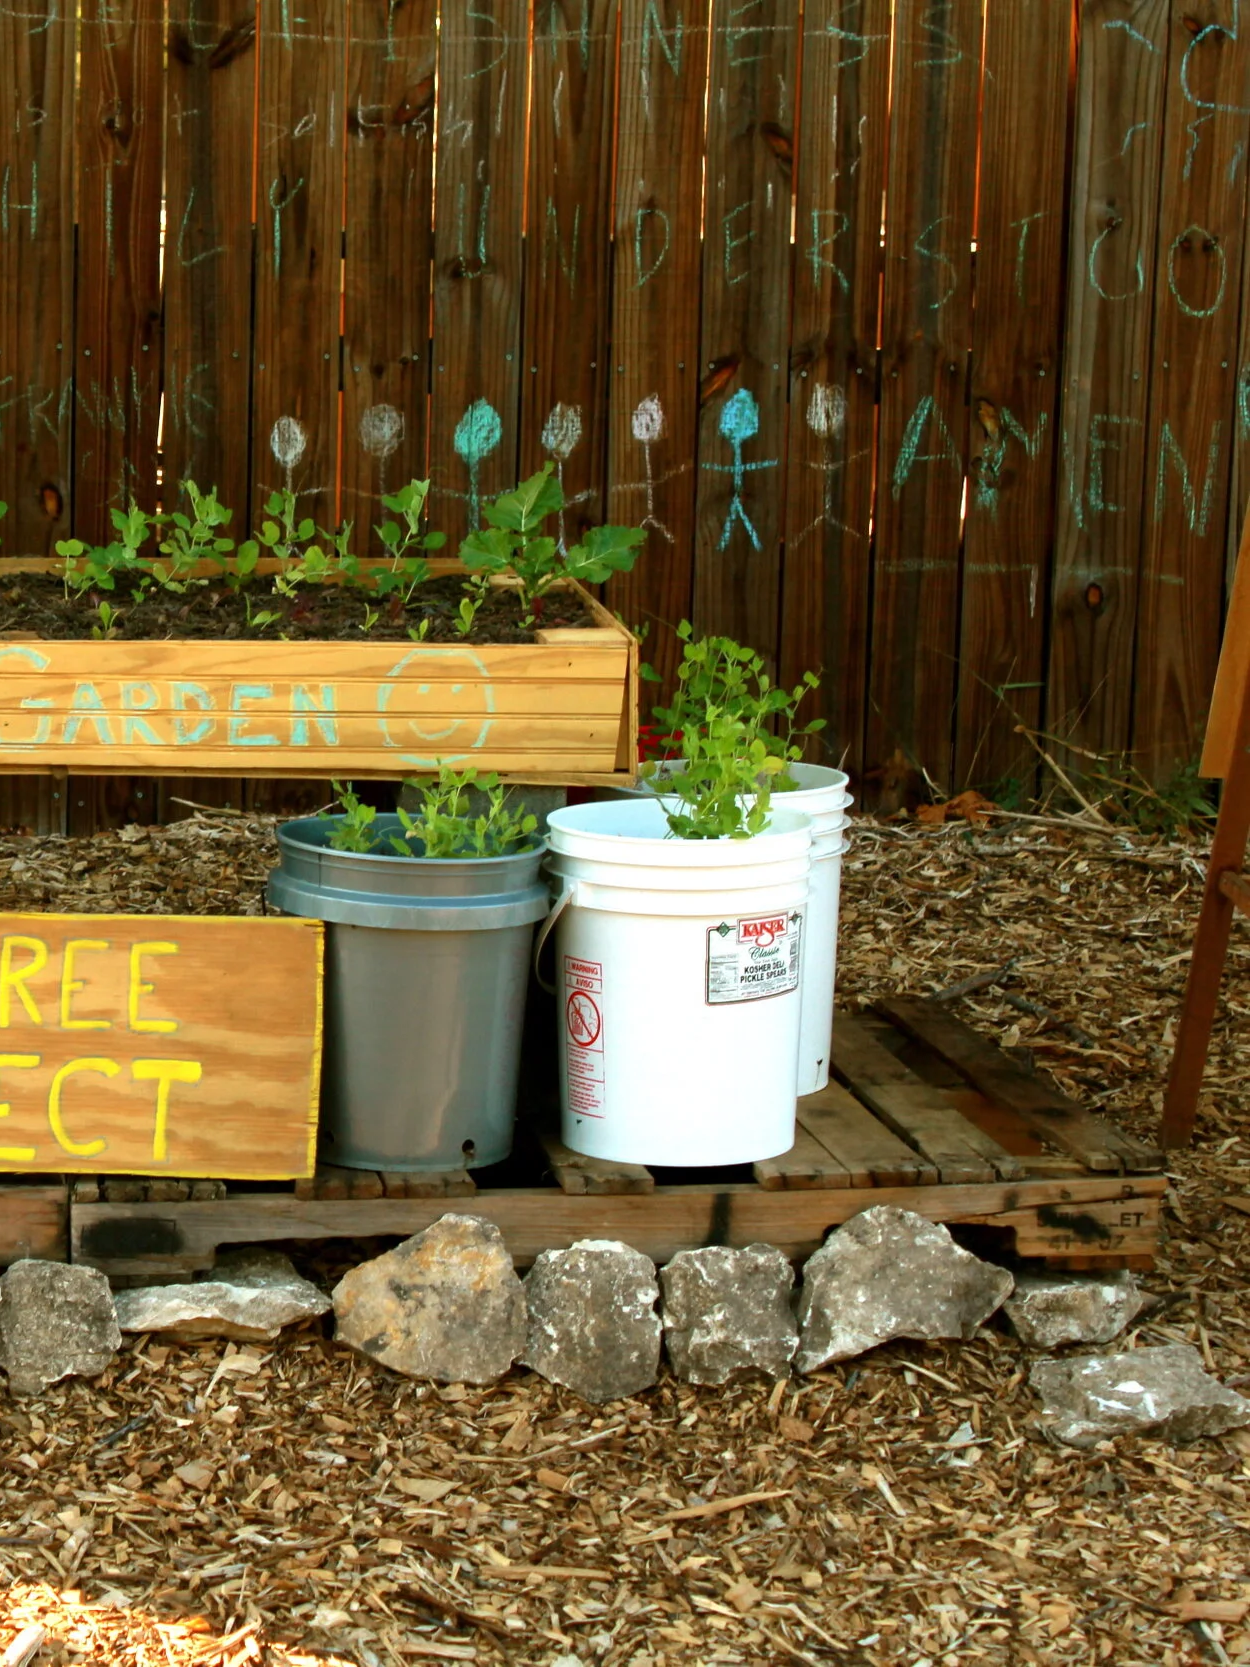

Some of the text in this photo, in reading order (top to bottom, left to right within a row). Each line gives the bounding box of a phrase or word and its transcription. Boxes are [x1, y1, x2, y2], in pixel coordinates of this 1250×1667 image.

[741, 919, 786, 947] KAISER
[570, 963, 599, 976] WARNING
[740, 967, 788, 983] PICKLE SPEARS
[744, 962, 772, 975] KOSHER
[575, 977, 594, 989] AVISO
